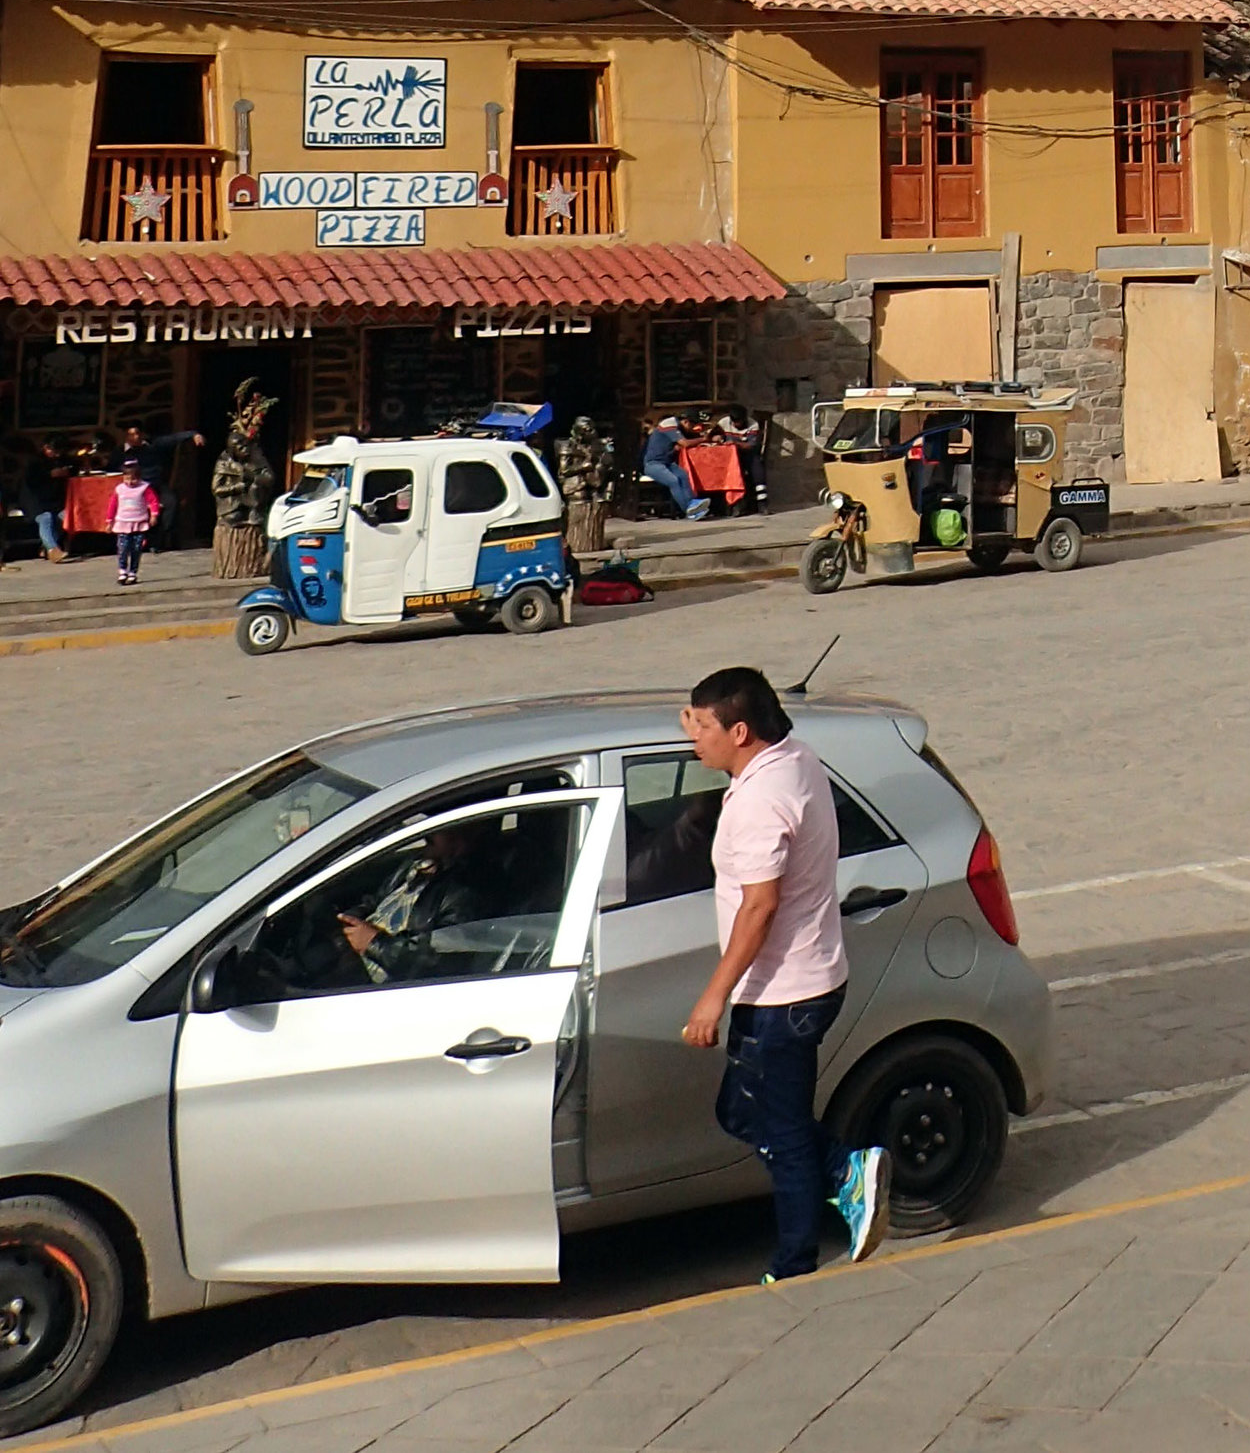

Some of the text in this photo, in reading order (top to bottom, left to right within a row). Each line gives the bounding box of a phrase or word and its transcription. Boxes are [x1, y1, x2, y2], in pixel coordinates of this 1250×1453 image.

[405, 132, 442, 144] PLAZA
[262, 175, 477, 207] WOOD FIRED
[319, 214, 424, 244] PIZZA
[56, 308, 317, 345] RESTAURANT
[454, 305, 592, 339] PIZZAS
[1059, 490, 1106, 505] GAMMA
